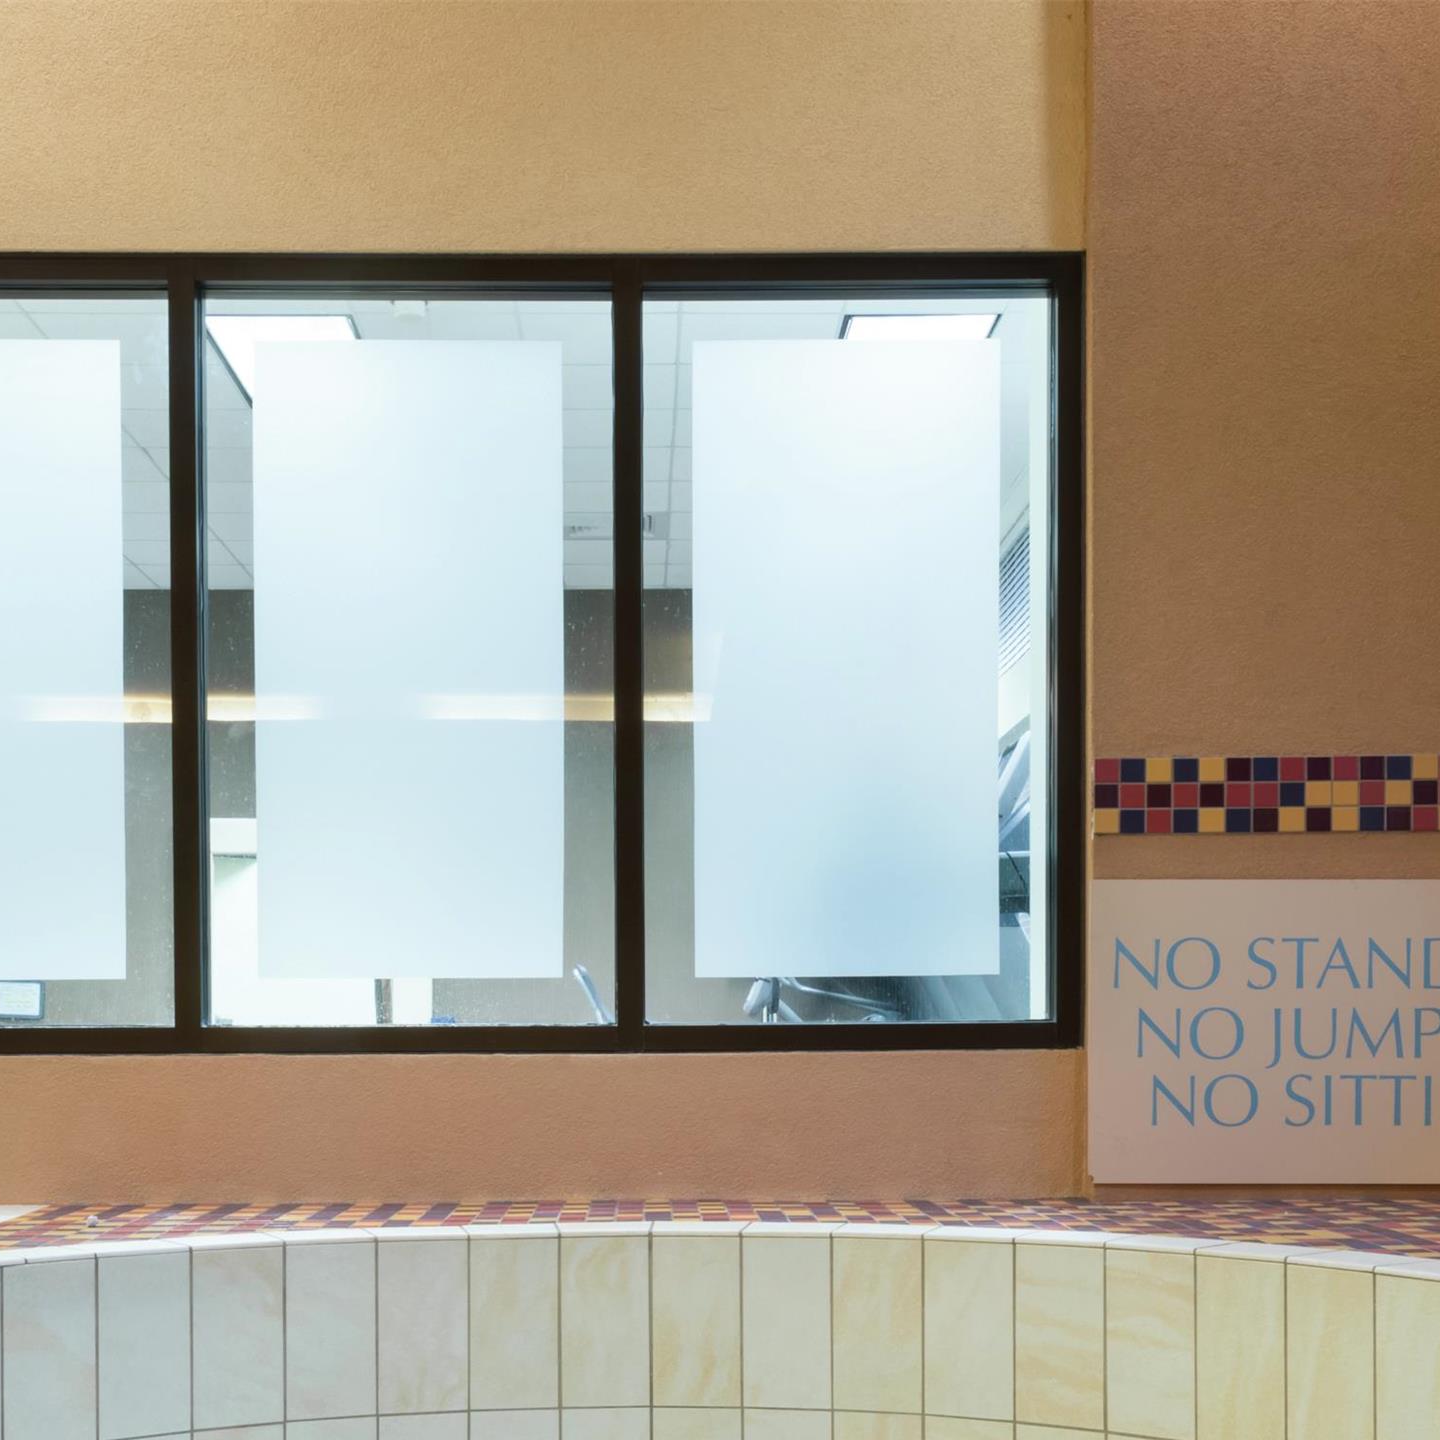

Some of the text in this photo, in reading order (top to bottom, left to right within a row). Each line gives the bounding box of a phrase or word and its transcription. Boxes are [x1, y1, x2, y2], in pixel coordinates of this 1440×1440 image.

[1113, 936, 1221, 991] NO
[1136, 1006, 1246, 1061] NO
[1152, 1073, 1259, 1127] NO
